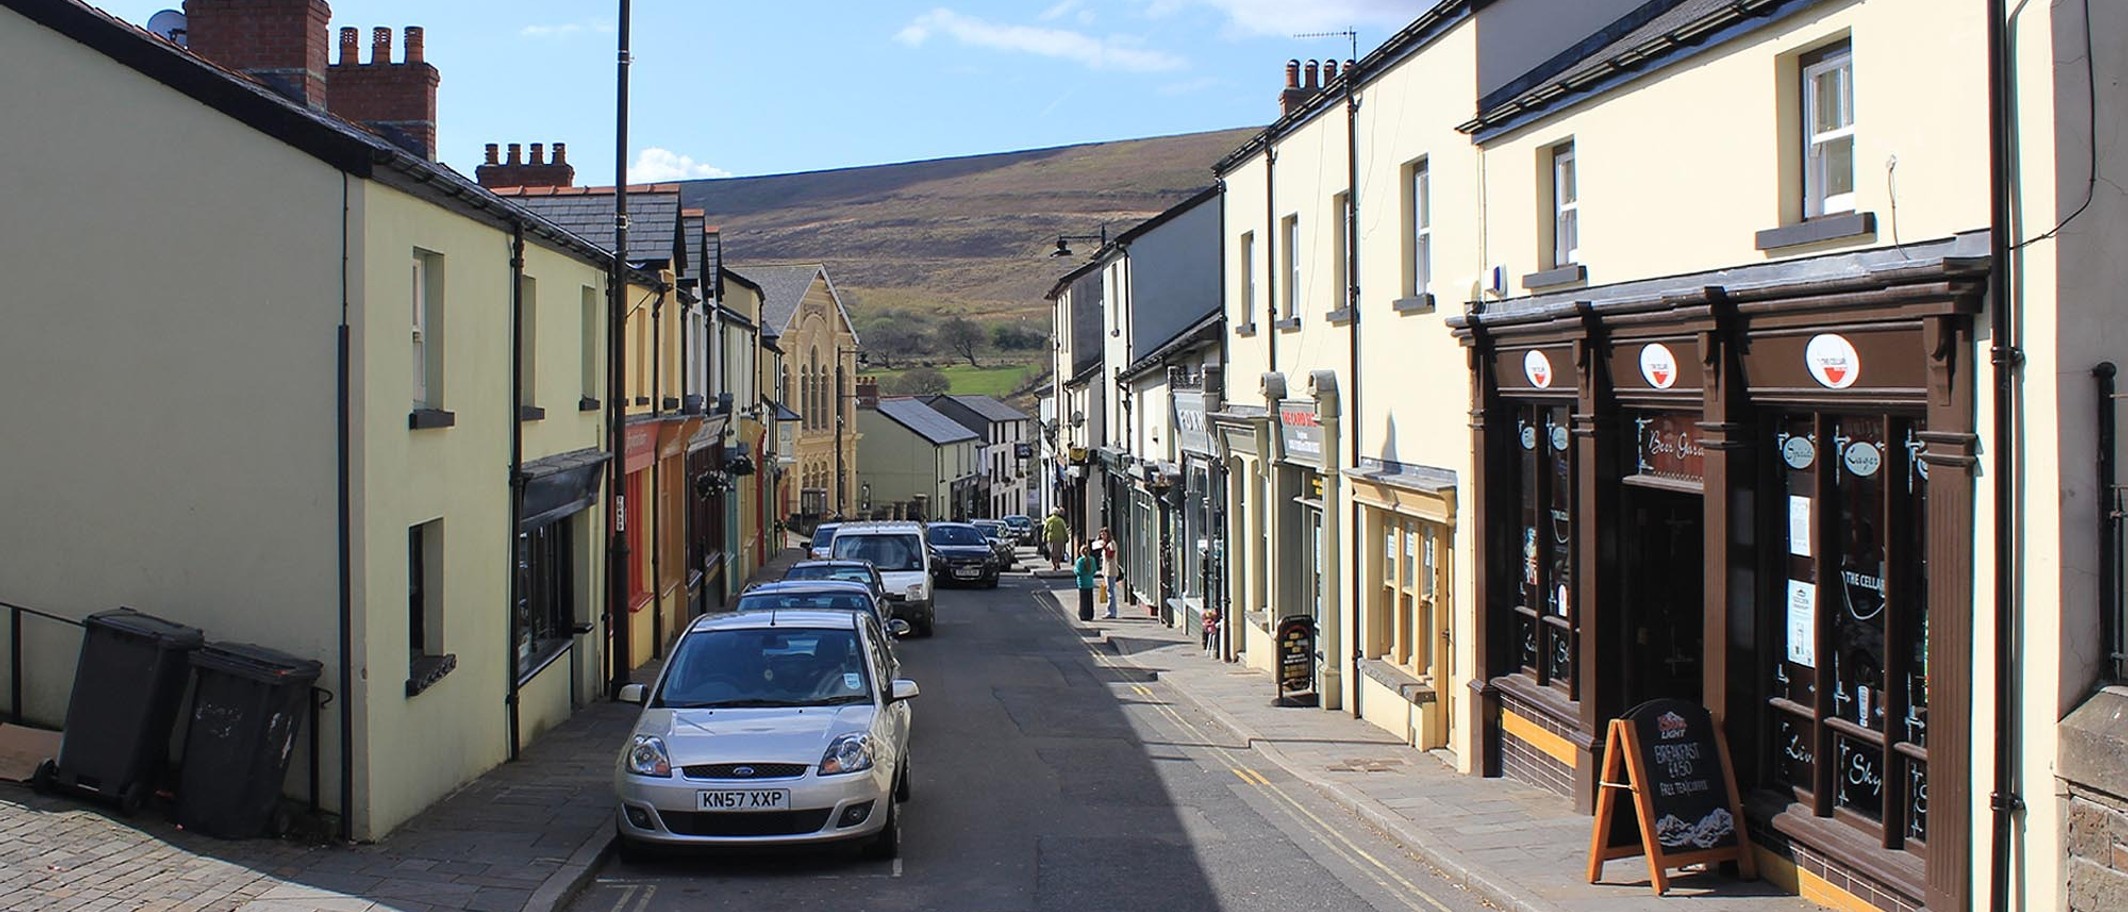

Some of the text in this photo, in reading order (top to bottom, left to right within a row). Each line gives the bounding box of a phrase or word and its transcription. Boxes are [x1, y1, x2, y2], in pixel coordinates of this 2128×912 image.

[1847, 446, 1878, 471] Lager
[1846, 570, 1860, 586] THE
[703, 791, 782, 808] KN57 XXP
